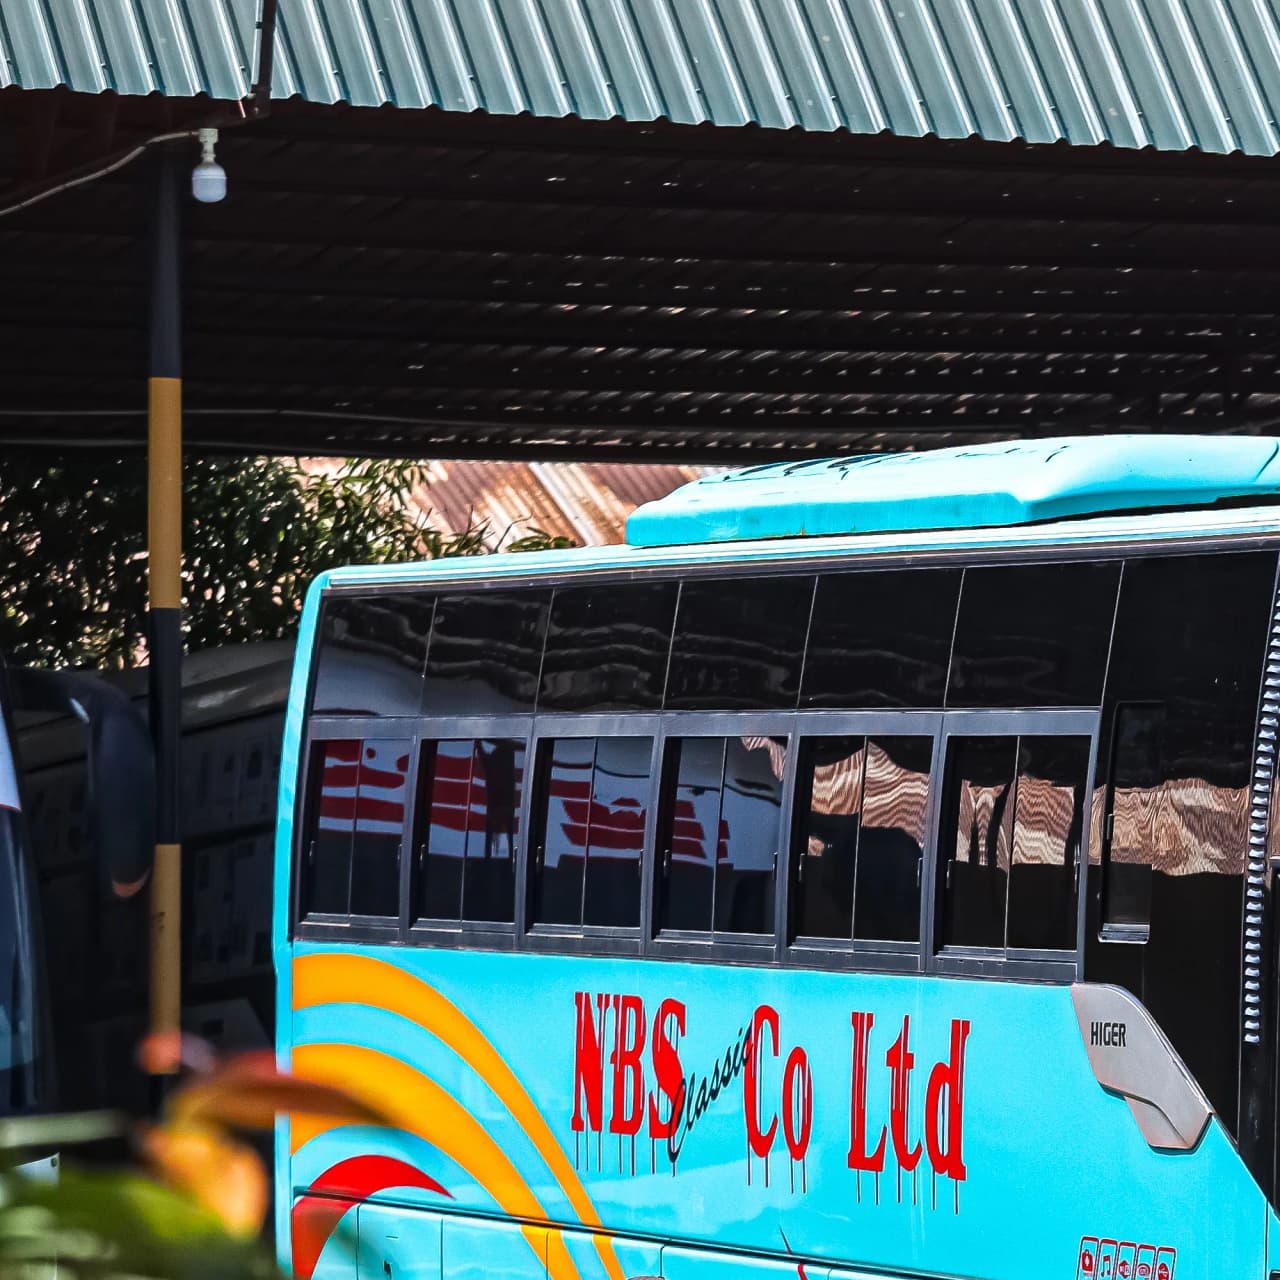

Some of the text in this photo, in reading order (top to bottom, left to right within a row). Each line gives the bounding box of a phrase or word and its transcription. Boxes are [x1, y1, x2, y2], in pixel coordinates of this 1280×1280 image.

[571, 992, 686, 1141] NBS
[743, 1004, 813, 1162] Co
[847, 1011, 971, 1181] Ltd
[1090, 1021, 1127, 1048] HIGER
